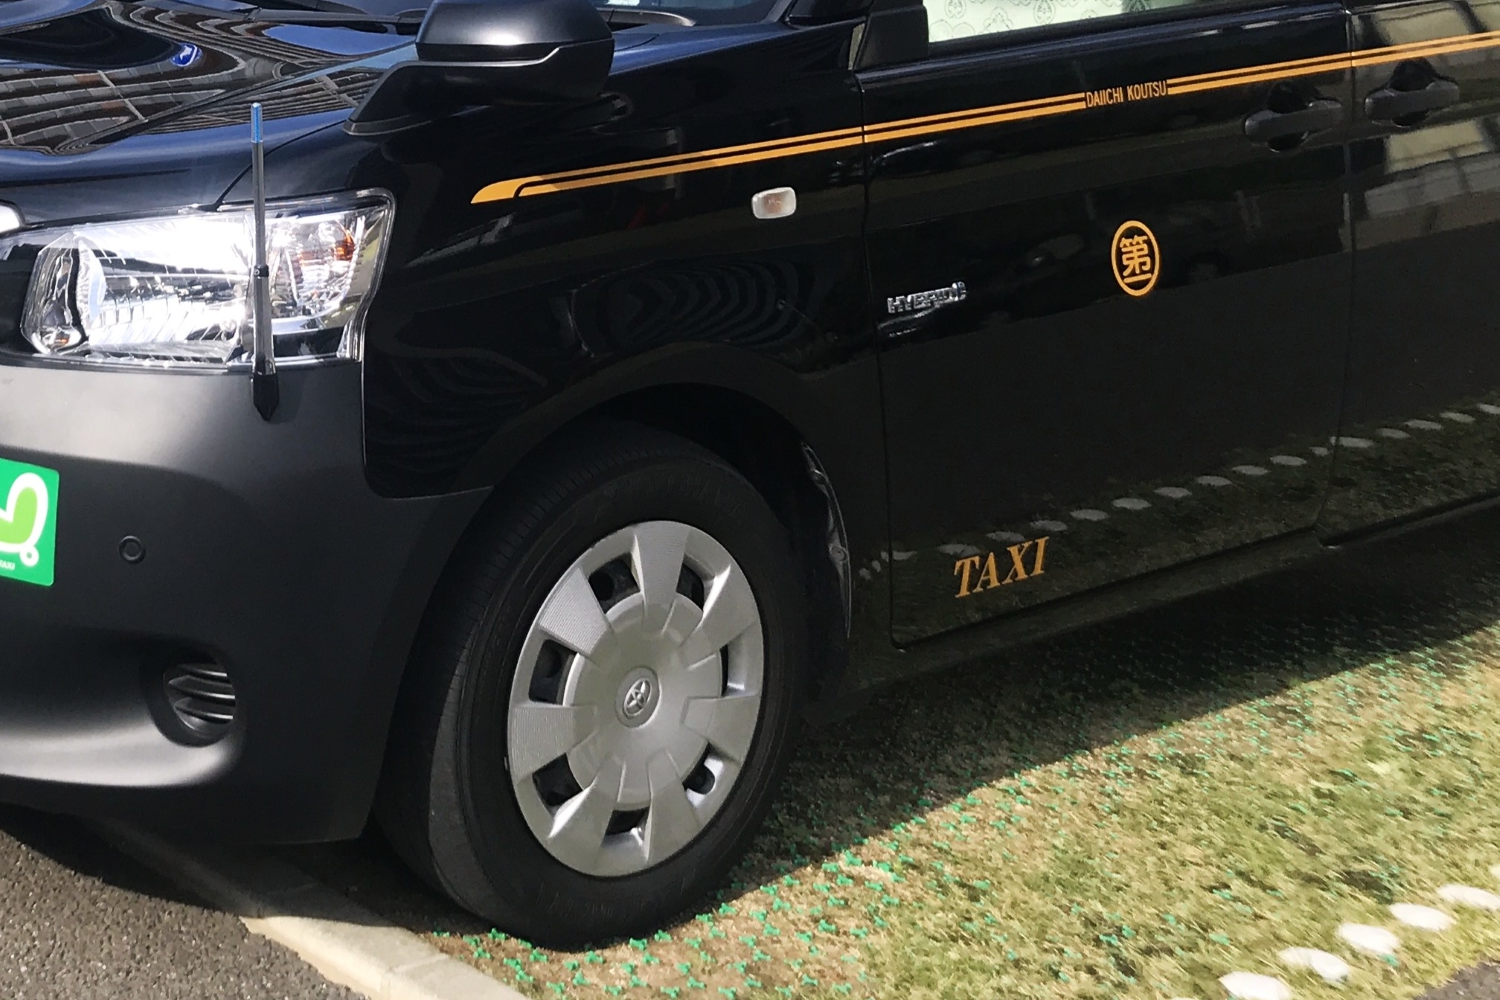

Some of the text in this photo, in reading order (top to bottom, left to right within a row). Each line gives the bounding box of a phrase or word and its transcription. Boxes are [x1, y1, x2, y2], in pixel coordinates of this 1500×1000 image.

[1086, 80, 1167, 108] DAIICHI KOUTSU
[1120, 234, 1152, 284] 第一
[887, 286, 959, 314] HYBRID
[953, 536, 1050, 598] TAXI
